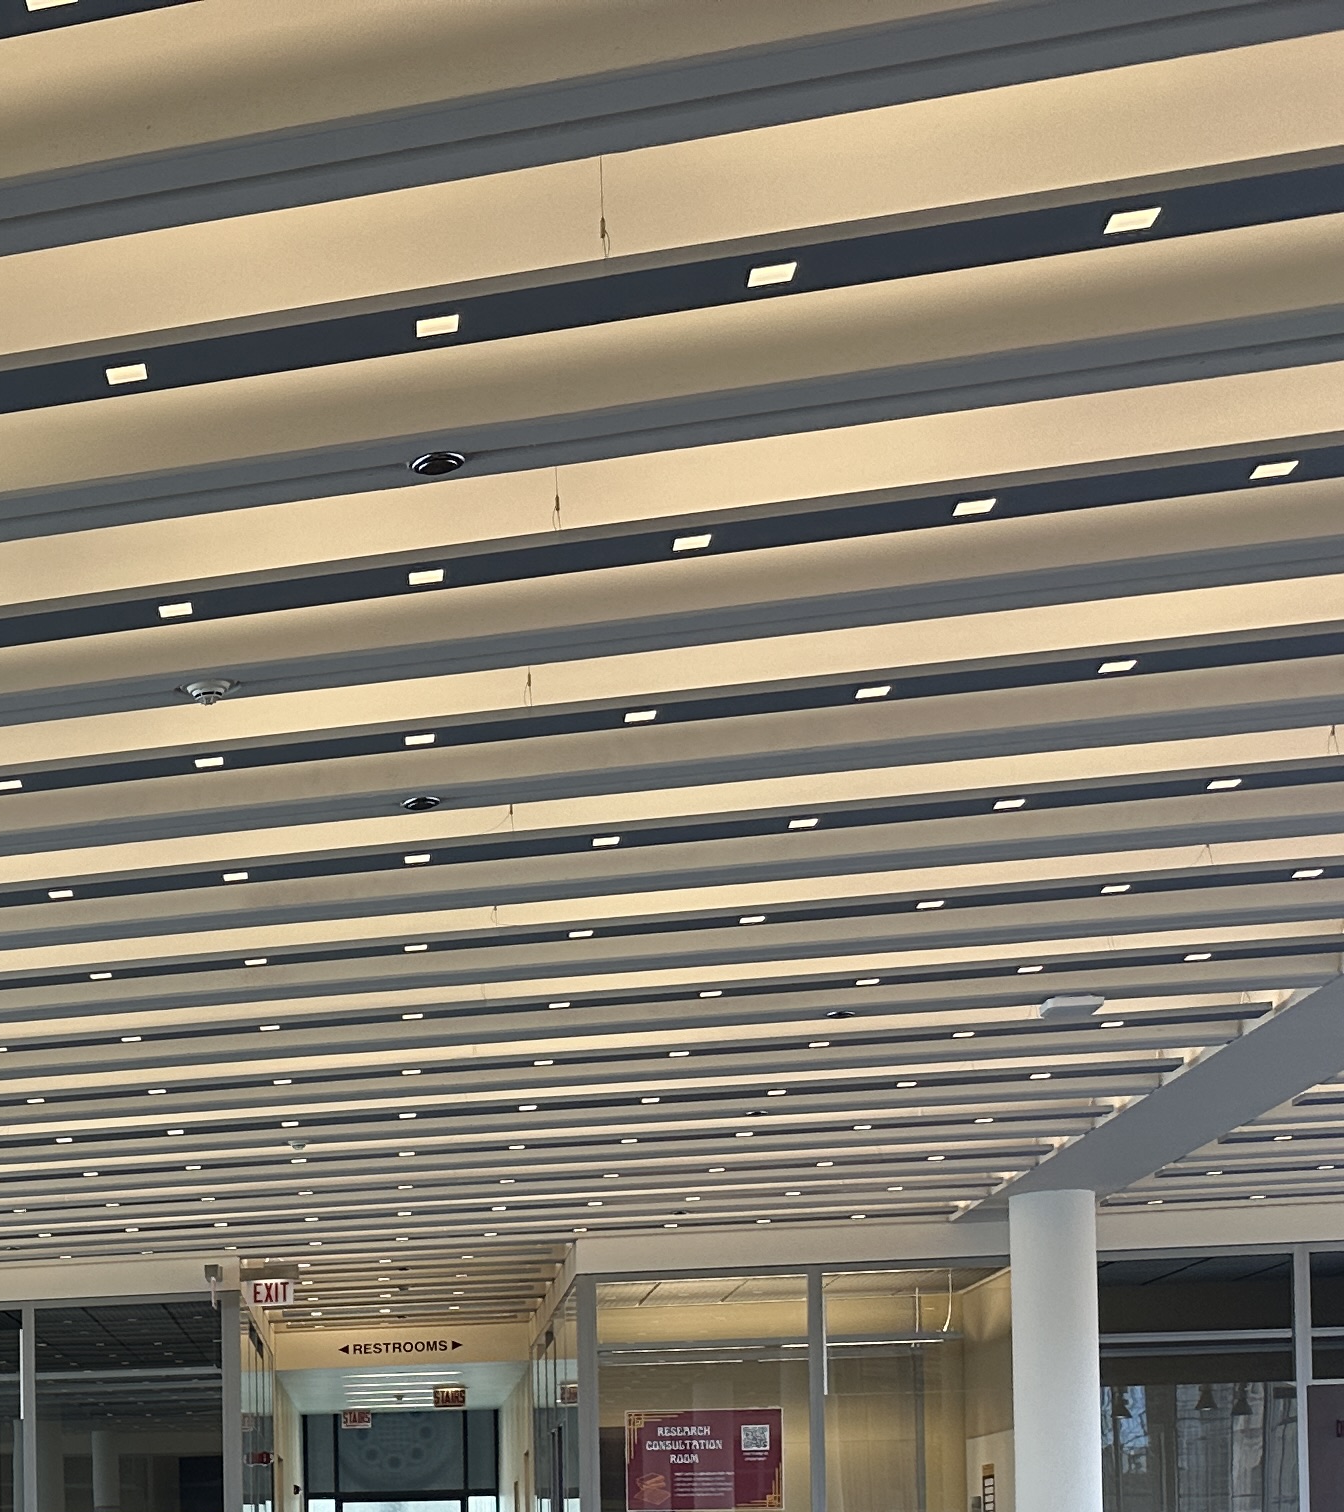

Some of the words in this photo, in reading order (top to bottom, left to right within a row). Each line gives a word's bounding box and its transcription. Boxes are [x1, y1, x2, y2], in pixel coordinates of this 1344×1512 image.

[253, 1281, 290, 1303] EXIT
[353, 1340, 448, 1355] RESTROOMS
[434, 1389, 466, 1405] STAIRS
[343, 1411, 371, 1425] STAIRS
[657, 1426, 711, 1437] RESEARCH
[645, 1440, 723, 1451] CONSULTATION
[670, 1454, 699, 1464] ROOM
